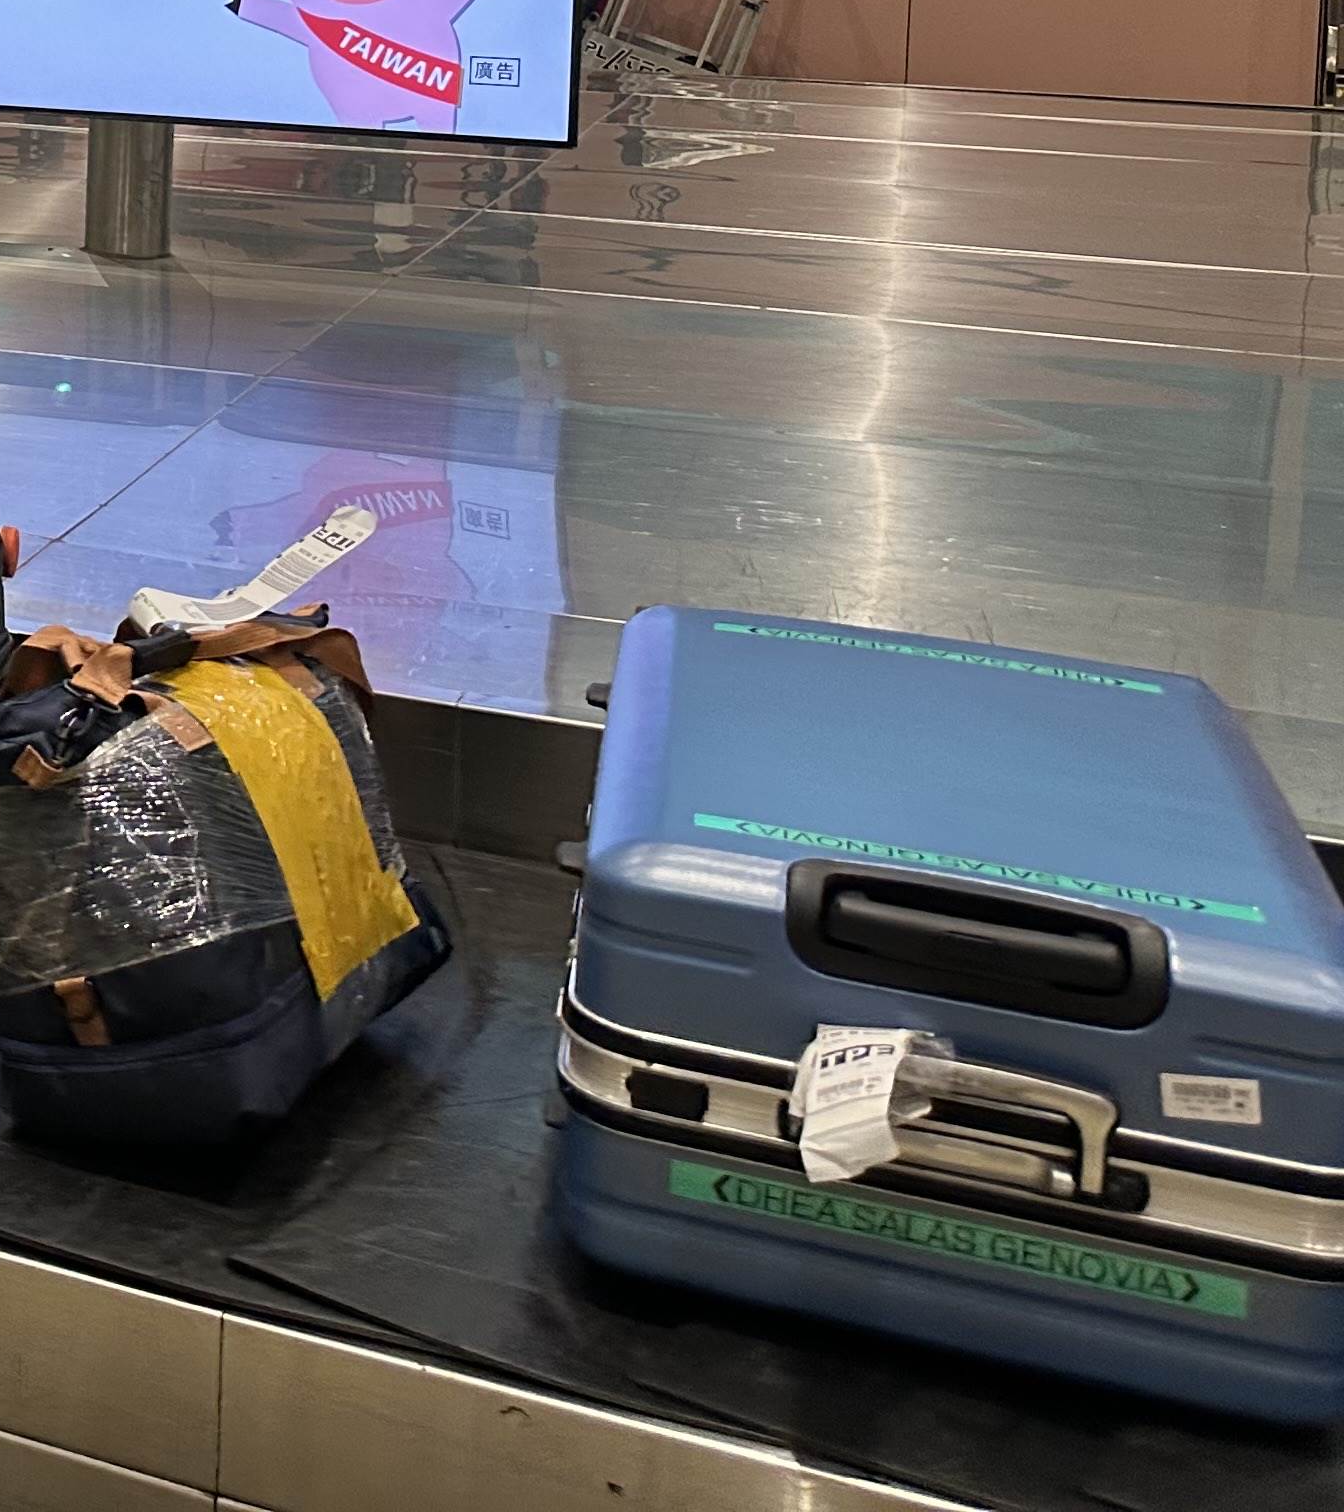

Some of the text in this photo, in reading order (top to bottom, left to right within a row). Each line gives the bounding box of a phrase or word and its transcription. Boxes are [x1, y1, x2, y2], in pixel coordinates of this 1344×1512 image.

[338, 26, 454, 92] TAIWAN
[474, 61, 515, 82] 廣告
[937, 854, 1062, 887] SALAS
[853, 1204, 977, 1255] SALAS
